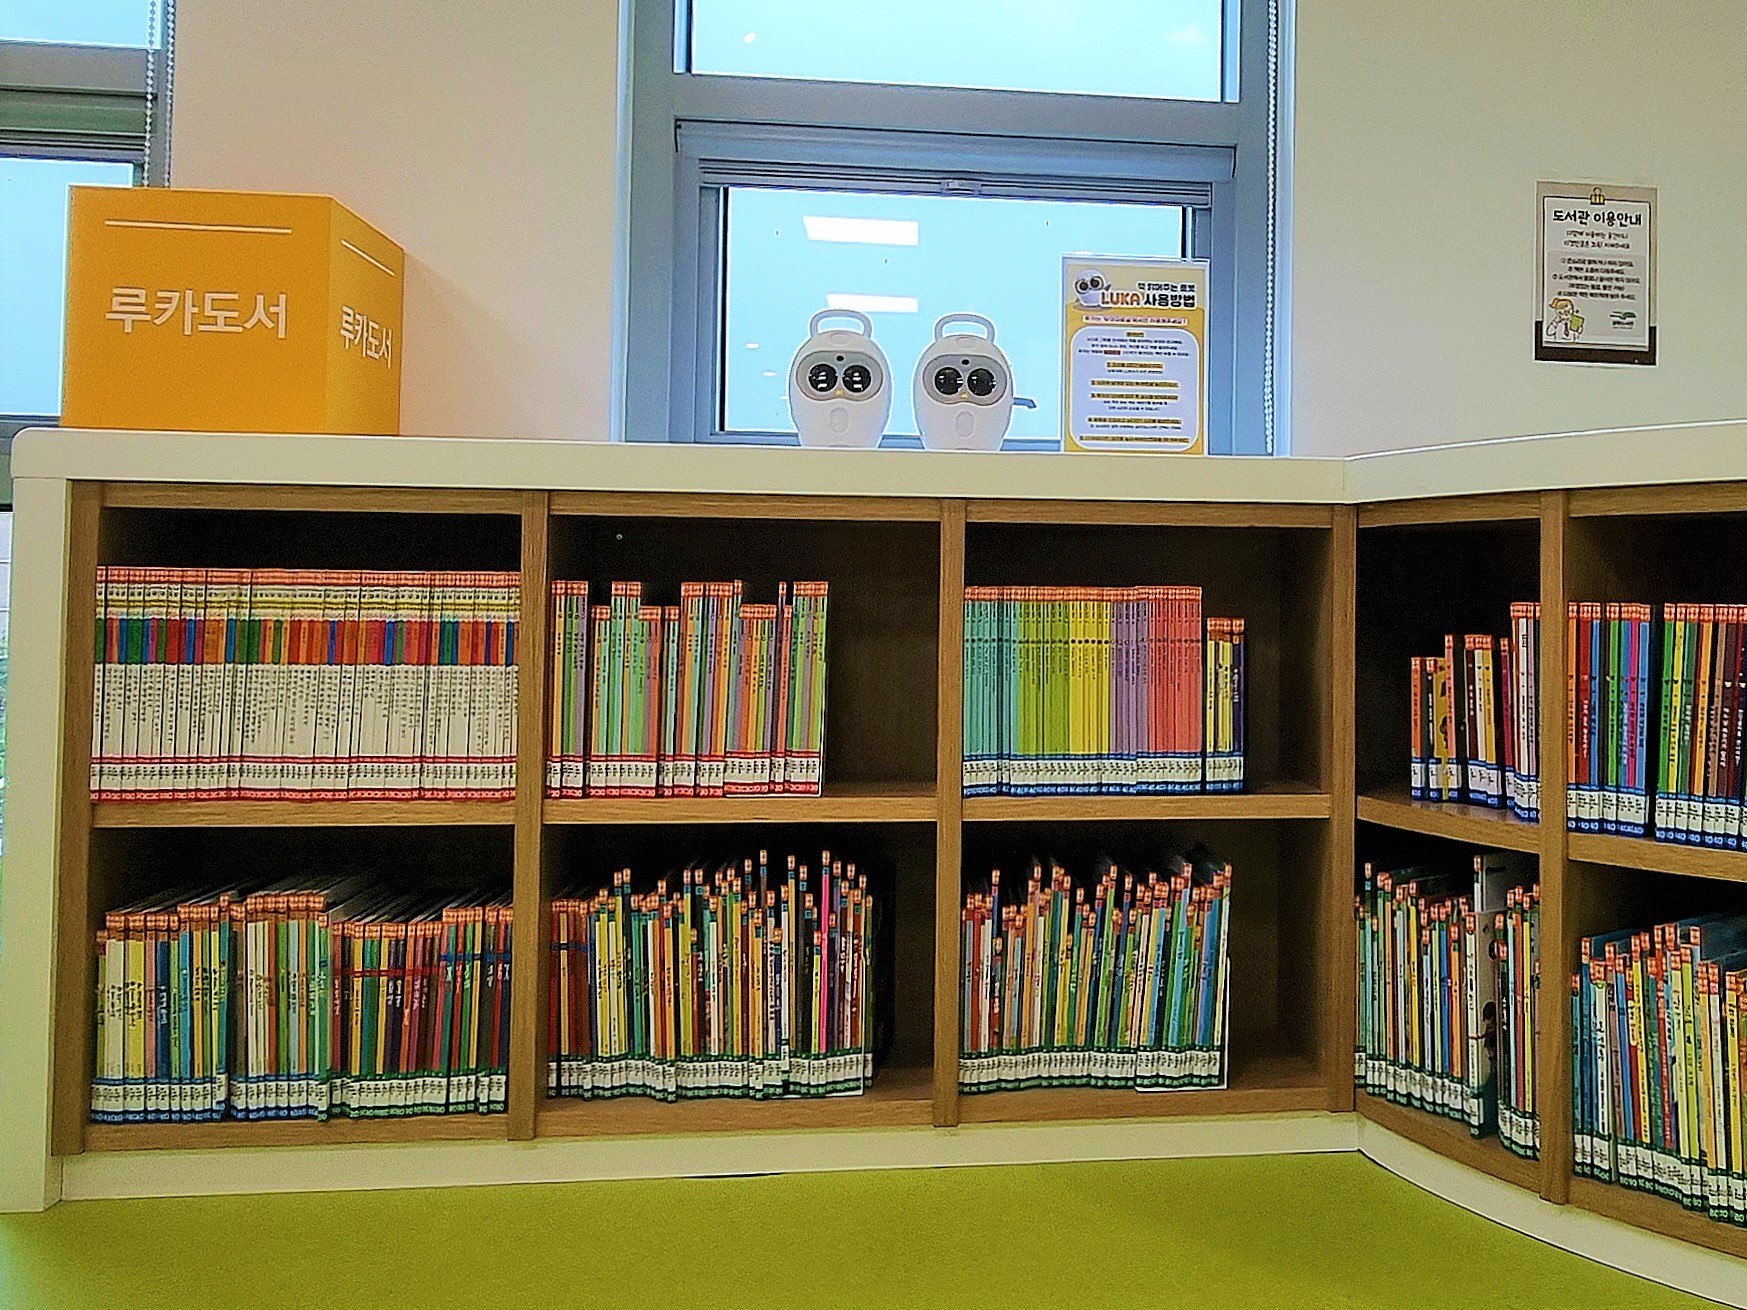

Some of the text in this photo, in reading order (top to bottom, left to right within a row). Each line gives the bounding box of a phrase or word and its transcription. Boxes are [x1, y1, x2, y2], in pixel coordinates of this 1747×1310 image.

[1552, 209, 1642, 228] 도서관 이용안내
[105, 286, 287, 339] 루카도서
[1101, 292, 1195, 308] LUKA 사용방법
[340, 305, 393, 369] 루카도서
